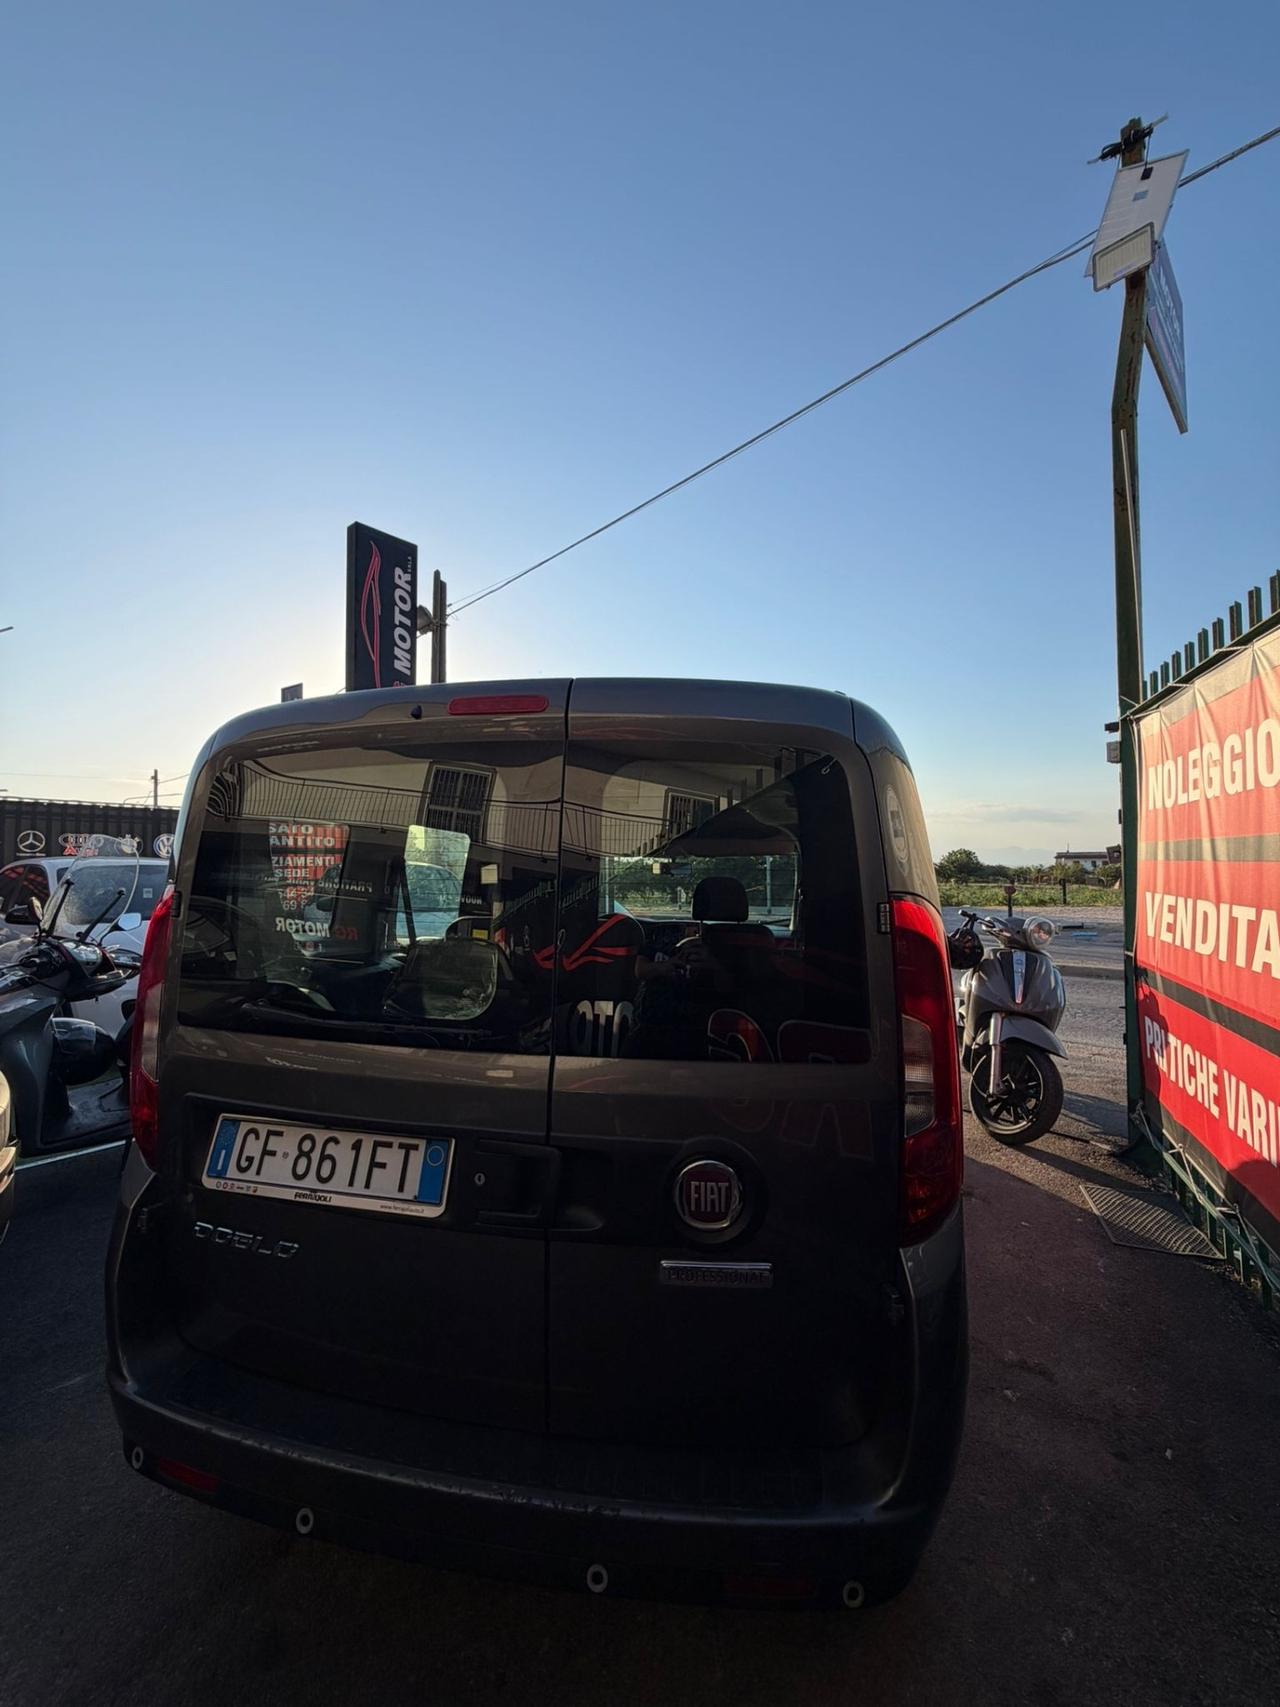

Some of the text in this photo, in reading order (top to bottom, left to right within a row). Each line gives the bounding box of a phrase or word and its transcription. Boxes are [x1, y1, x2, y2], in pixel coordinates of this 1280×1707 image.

[393, 567, 412, 677] MOTOR
[1148, 717, 1280, 811] NOLEGGIO
[269, 823, 314, 834] SATO
[269, 835, 335, 847] ANTITO
[271, 856, 335, 867] ZIAMENTI
[273, 868, 309, 877] SEDE
[1145, 891, 1280, 981] VENDITA
[1223, 1068, 1280, 1168] VARI
[236, 1127, 285, 1176] GF
[291, 1133, 420, 1193] 861FT
[689, 1180, 730, 1213] FIAT
